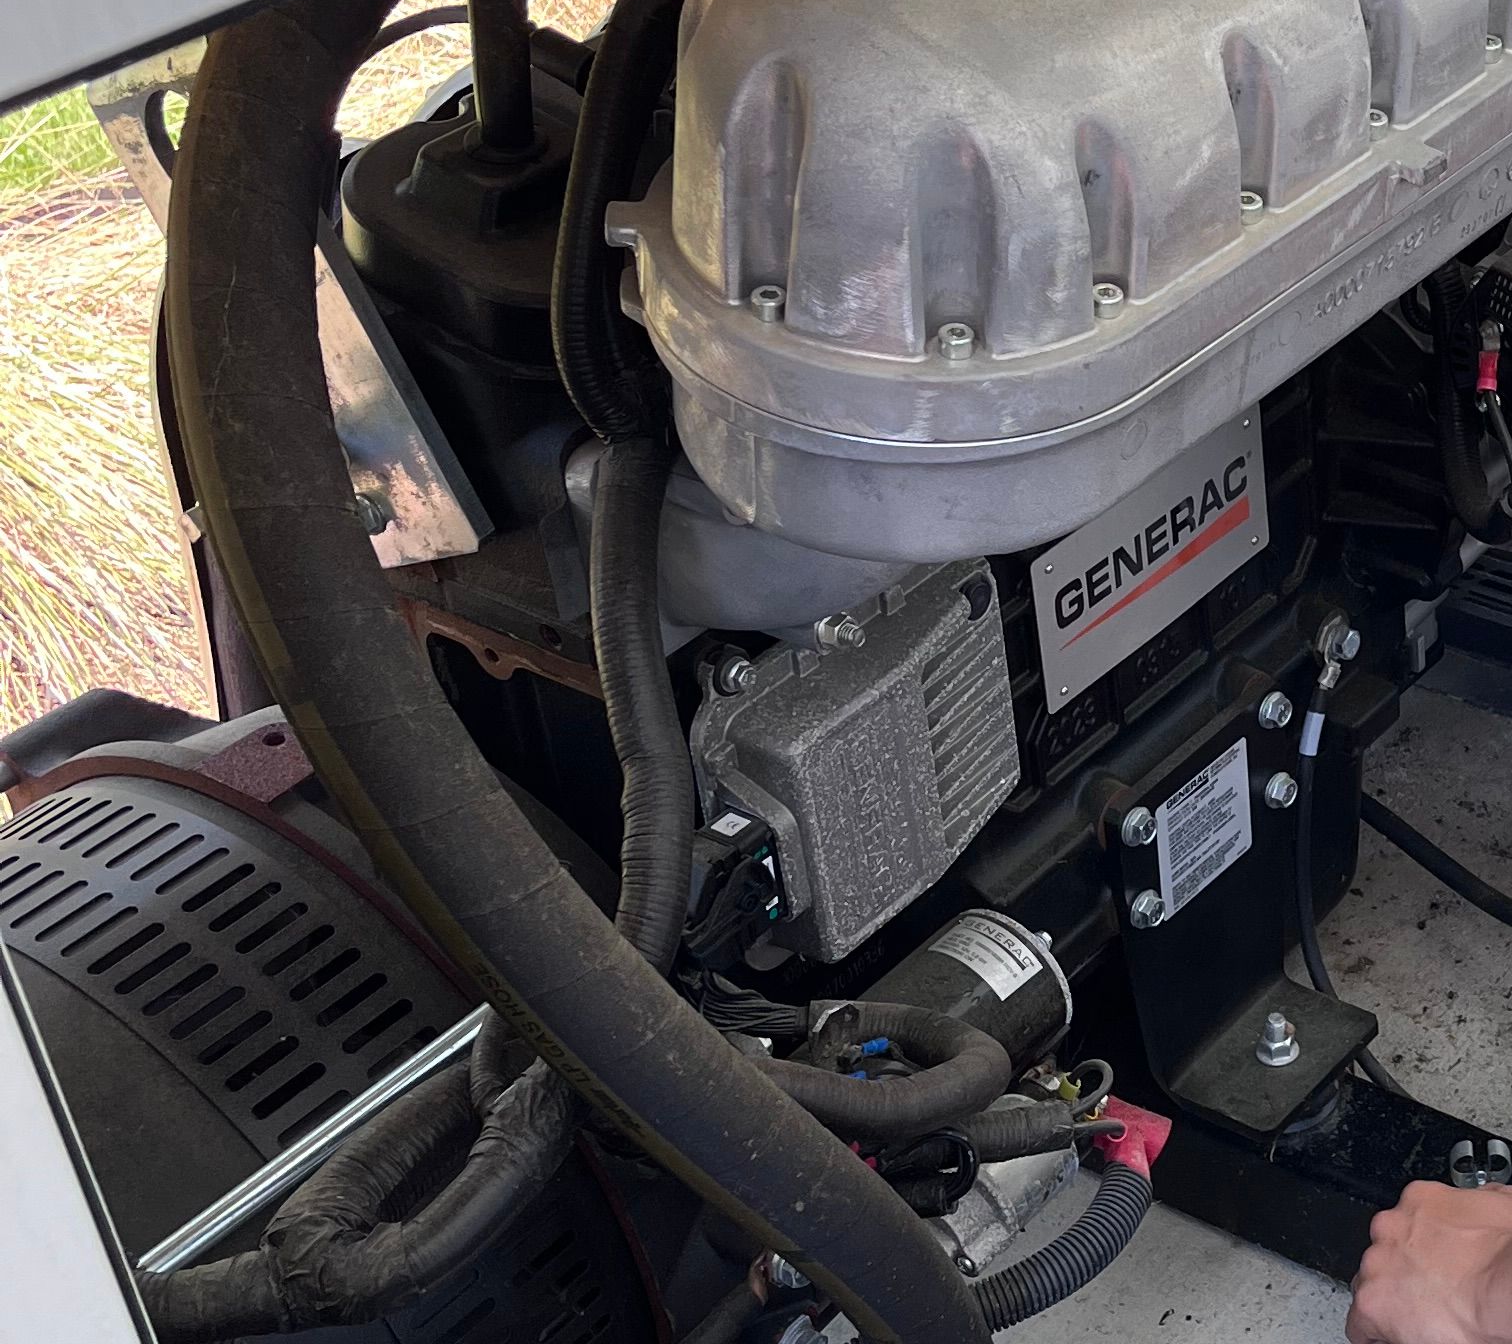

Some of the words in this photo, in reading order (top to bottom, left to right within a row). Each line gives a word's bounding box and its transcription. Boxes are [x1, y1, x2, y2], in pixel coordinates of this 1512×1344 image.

[1055, 455, 1248, 630] GENERAC
[1166, 768, 1210, 810] GENERAC
[964, 919, 1035, 968] GENERAC
[471, 961, 526, 1017] HOSE
[521, 1020, 566, 1058] GAS
